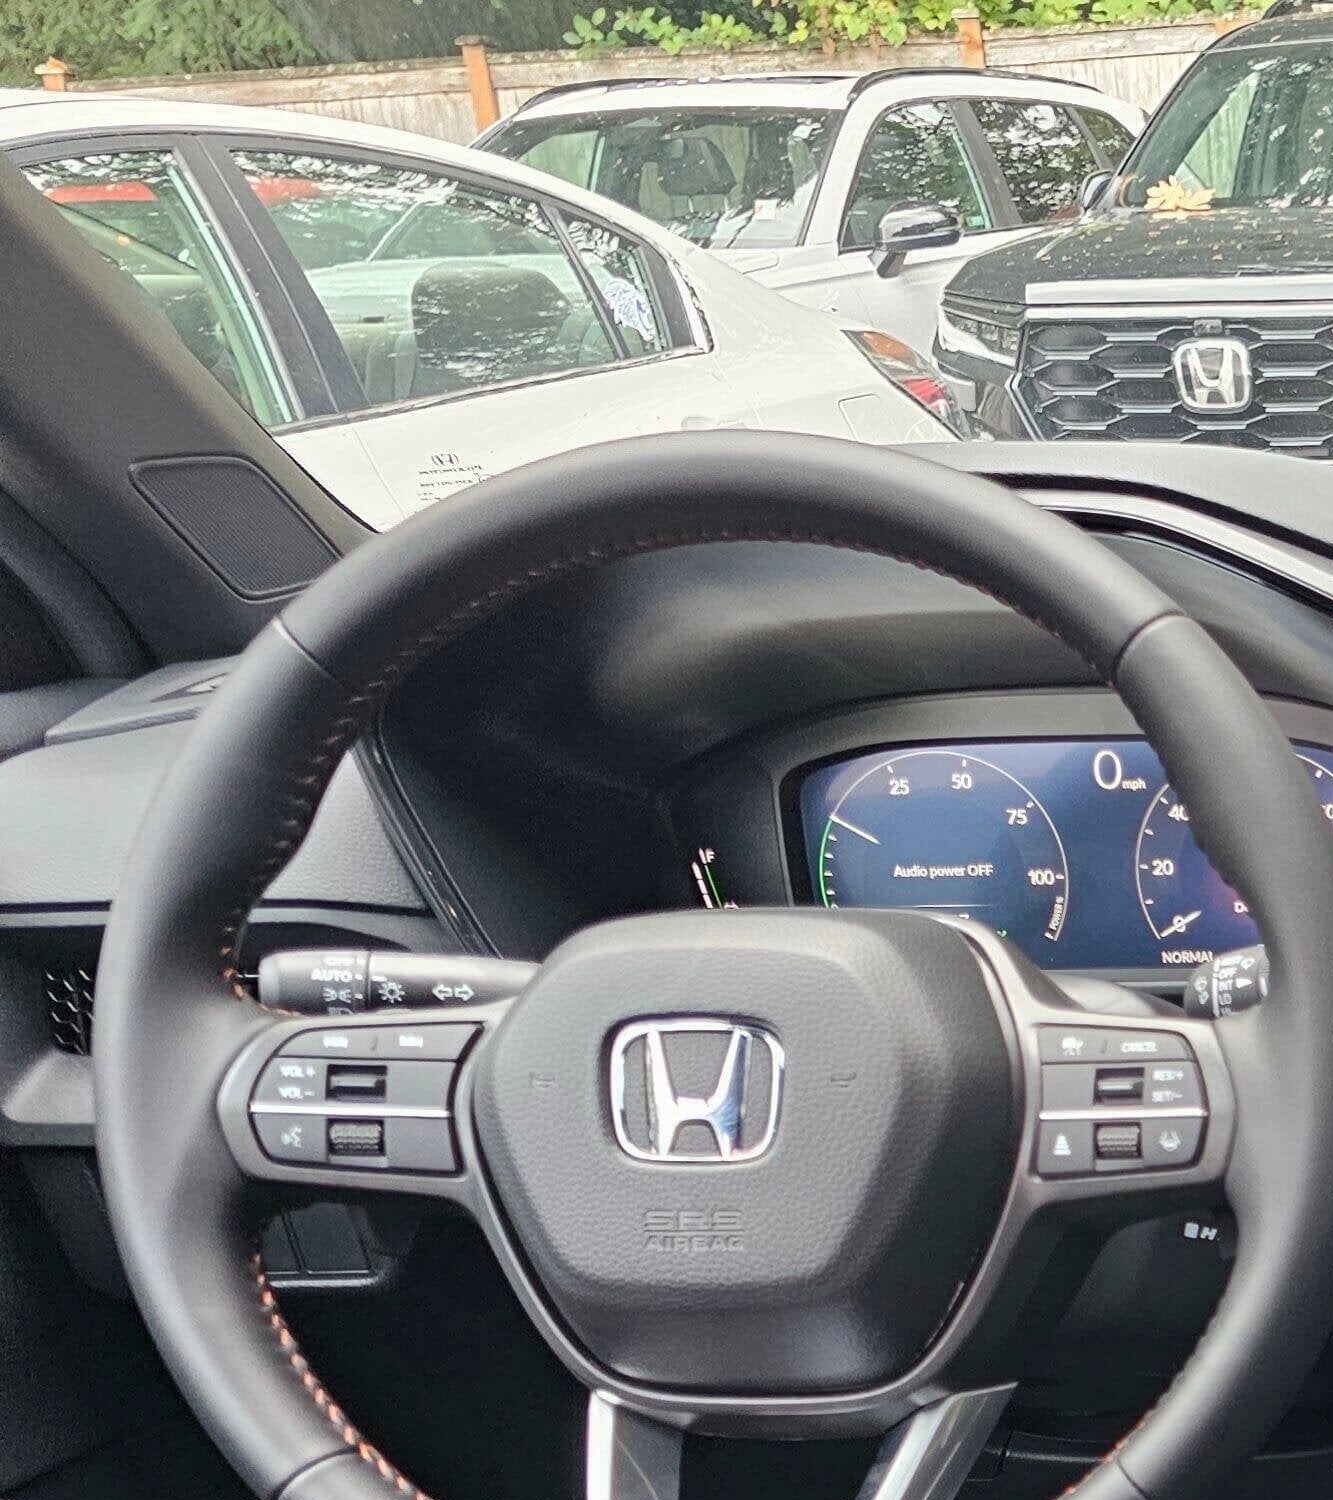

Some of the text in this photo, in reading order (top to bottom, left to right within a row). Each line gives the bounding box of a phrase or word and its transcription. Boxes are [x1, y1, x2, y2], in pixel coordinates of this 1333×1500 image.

[1093, 750, 1147, 792] 0 mph
[889, 779, 910, 796] 25
[951, 773, 973, 790] 50
[1006, 808, 1028, 826] 75
[893, 864, 994, 880] Audio power OFF
[1152, 859, 1175, 876] 20
[1027, 869, 1055, 886] 100
[310, 968, 353, 983] AUTO
[280, 1065, 305, 1078] VOL
[278, 1086, 304, 1099] VOL
